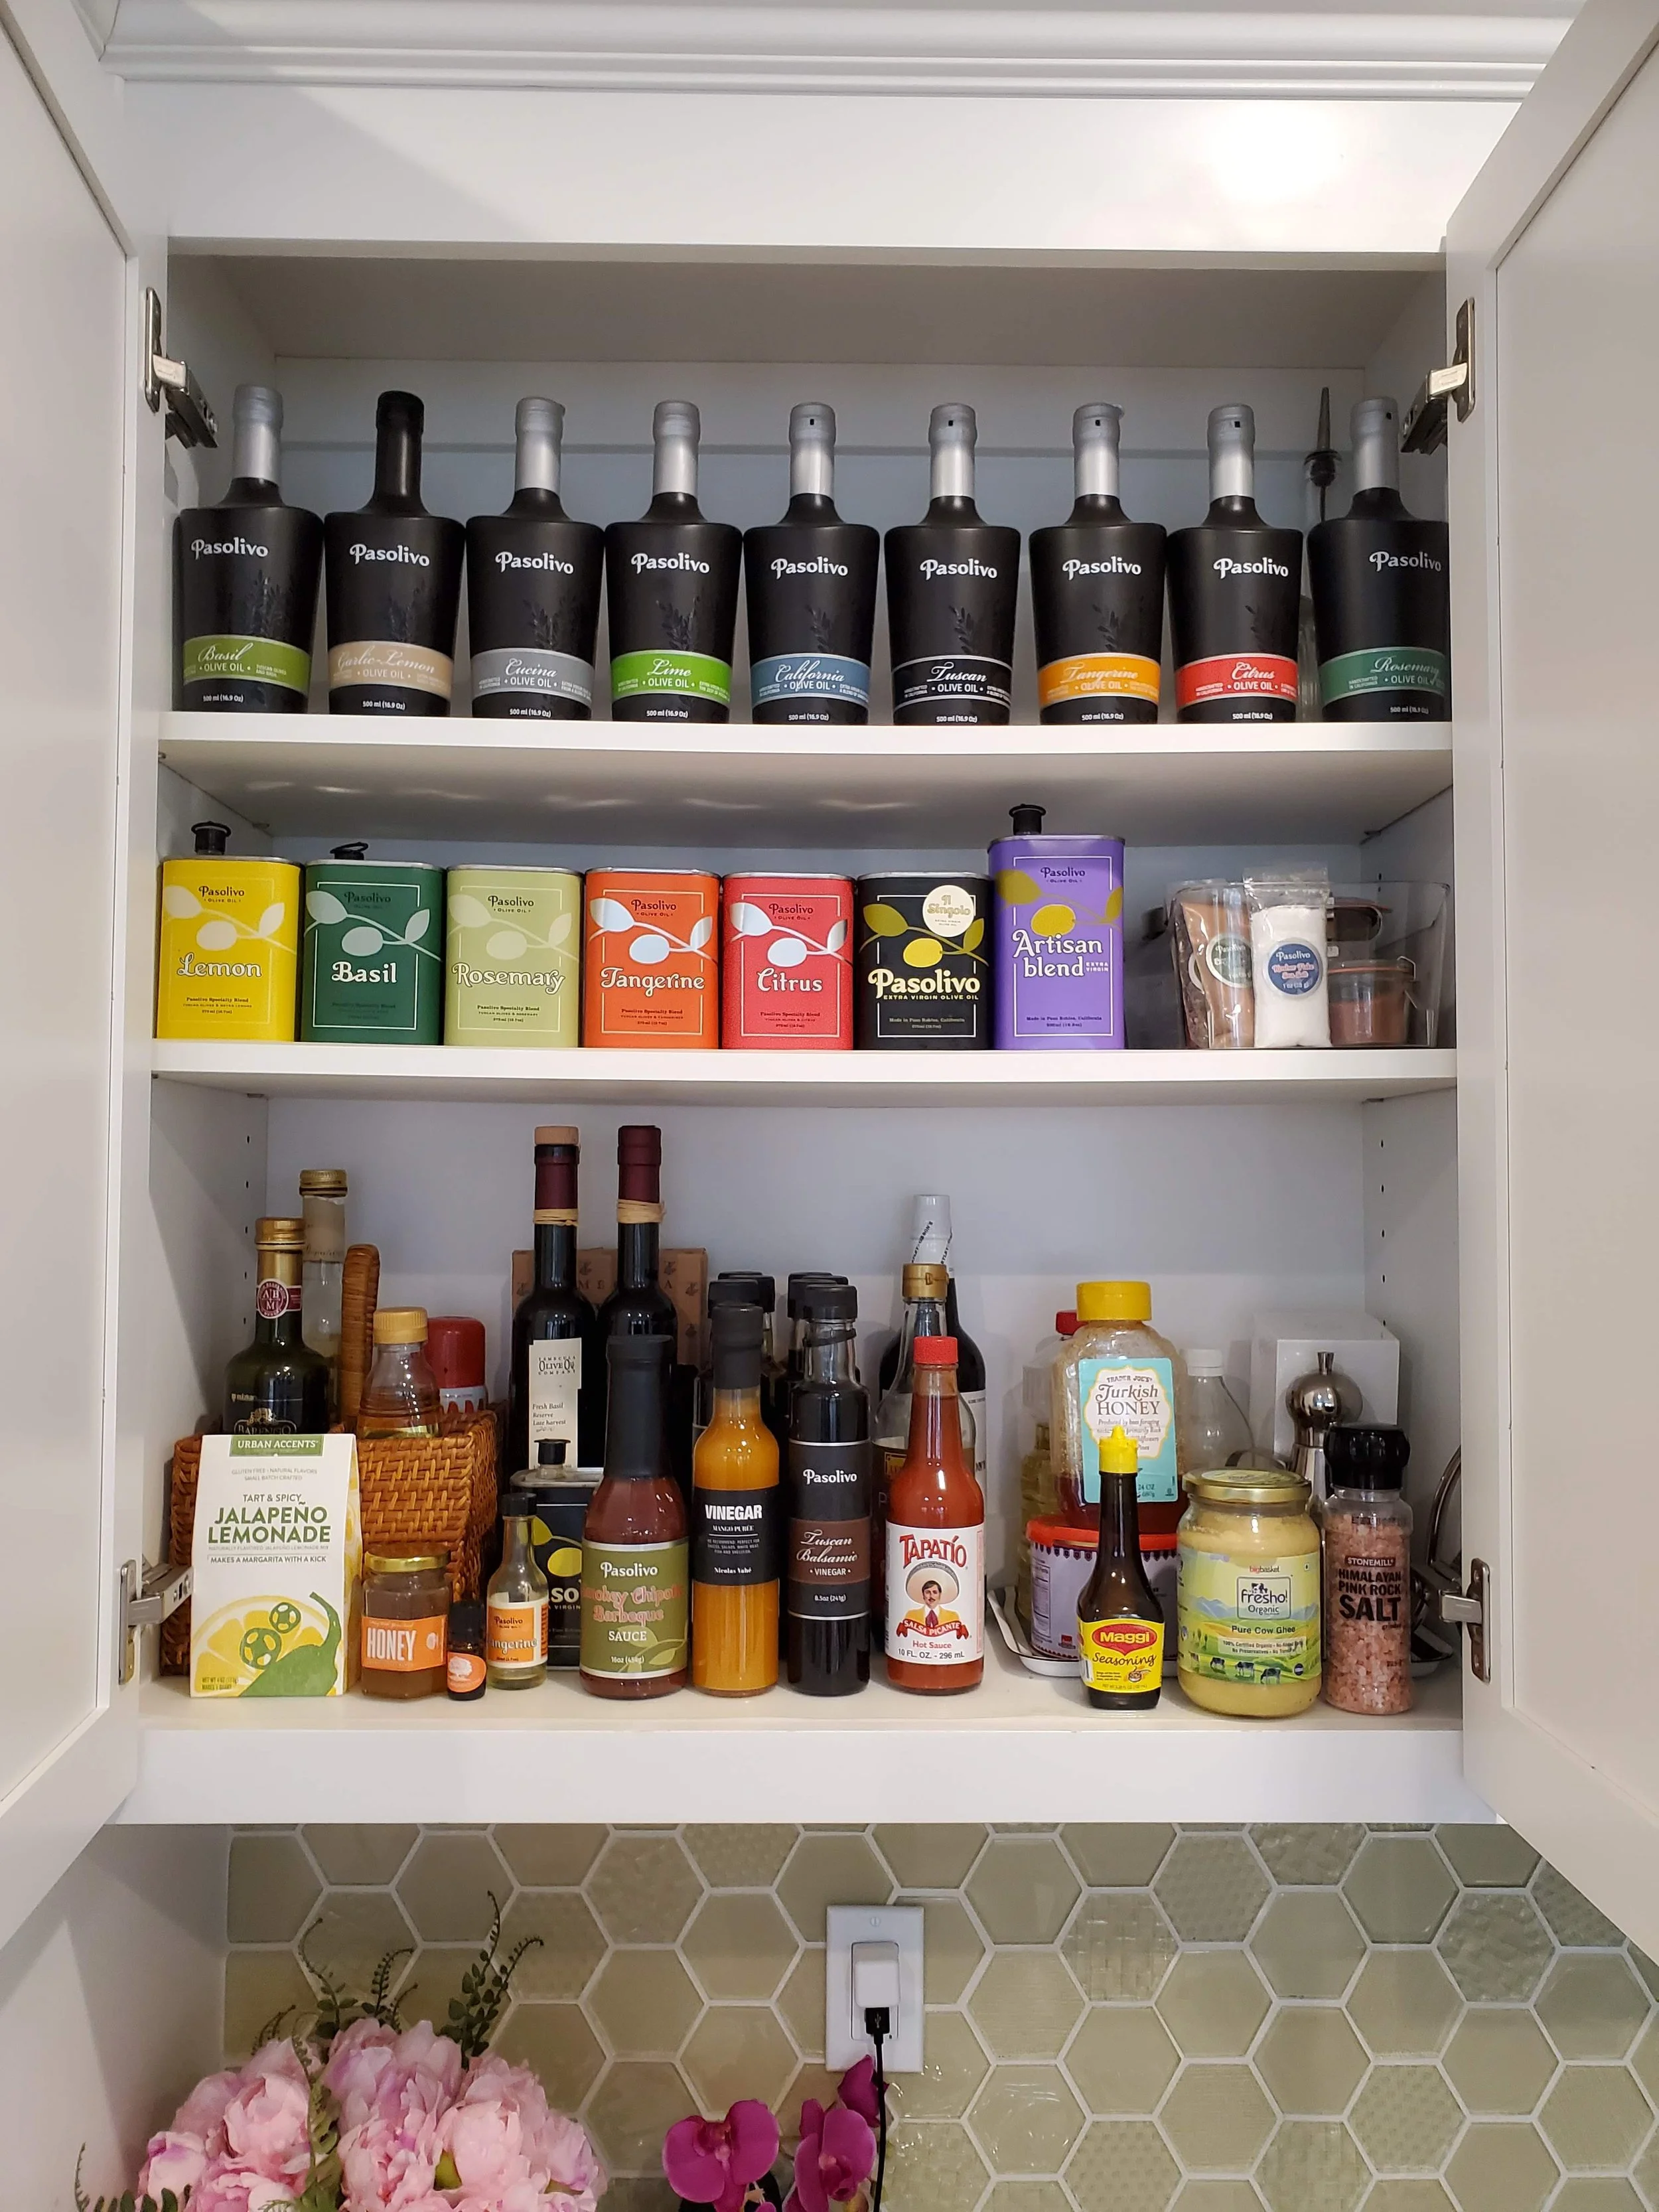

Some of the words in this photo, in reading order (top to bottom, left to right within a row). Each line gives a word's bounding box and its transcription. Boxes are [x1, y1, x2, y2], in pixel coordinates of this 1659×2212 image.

[191, 538, 268, 559] Pasolivo
[350, 544, 430, 567] Pasolivo
[495, 552, 573, 575] Pasolivo
[631, 552, 710, 574] Pasolivo
[770, 556, 849, 579] Pasolivo
[920, 558, 997, 580] Pasolivo
[1062, 556, 1141, 580] Pasolivo
[1213, 557, 1289, 579] Pasolivo
[1369, 551, 1441, 573] Pasolivo
[198, 642, 253, 662] Basil
[204, 663, 226, 672] OLIVE
[230, 663, 244, 672] OIL
[363, 669, 388, 678] OLIVE
[391, 670, 404, 679] OIL
[506, 658, 557, 677] Cucina
[647, 658, 691, 676] Lime
[926, 662, 987, 682] Tuscan
[1060, 662, 1139, 686] Tangerine
[1232, 662, 1275, 680] Citrus
[1370, 655, 1439, 685] Rosemary
[510, 677, 535, 686] OLIVE
[538, 678, 551, 688] OIL
[648, 678, 673, 687] OLIVE
[675, 678, 689, 688] OIL
[775, 660, 845, 692] California
[1417, 676, 1429, 685] OIL
[790, 681, 814, 690] OLIVE
[816, 681, 830, 690] OIL
[937, 684, 963, 692] OLIVE
[964, 684, 978, 693] OIL
[1080, 681, 1106, 690] OLIVE
[1108, 681, 1122, 690] OIL
[1234, 682, 1259, 690] OLIVE
[1260, 682, 1273, 690] OIL
[1041, 867, 1086, 878] Pasolivo
[198, 886, 245, 898] Pasolivo
[344, 891, 392, 903] Pasolivo
[488, 895, 534, 907] Pasolivo
[631, 899, 677, 911] Pasolivo
[768, 903, 814, 915] Pasolivo
[927, 903, 971, 919] Singolo
[1012, 929, 1103, 958] Artisan
[1276, 950, 1311, 962] Pasolivo
[177, 952, 262, 978] Lemon
[331, 960, 397, 984] Basil
[1023, 956, 1085, 978] blend
[452, 962, 565, 994] Rosemary
[600, 967, 705, 997] Tangerine
[757, 968, 824, 992] Citrus
[868, 968, 981, 999] Pasolivo
[539, 1361, 563, 1372] OLIVE
[1096, 1384, 1158, 1401] Turkish
[1097, 1401, 1160, 1416] HONEY
[238, 1440, 271, 1449] URBAN
[274, 1439, 317, 1449] ACCENTS
[803, 1469, 857, 1485] Pasolivo
[243, 1494, 264, 1503] TART
[275, 1494, 302, 1503] SPICY
[214, 1501, 328, 1524] JALAPEÑO
[705, 1505, 762, 1520] VINEGAR
[208, 1526, 331, 1544] LEMONADE
[800, 1529, 853, 1546] Tuscan
[796, 1545, 858, 1563] Balsamic
[899, 1534, 967, 1569] TAPATÍO
[600, 1562, 658, 1578] Pasolivo
[1250, 1566, 1279, 1574] bigbasket
[1348, 1558, 1392, 1567] STONEMILL
[814, 1568, 846, 1576] VINEGAR
[1338, 1568, 1401, 1583] HIMALAYAN
[1241, 1589, 1288, 1603] fresho!
[1338, 1581, 1366, 1594] PINK
[1370, 1584, 1401, 1595] ROCK
[830, 1593, 846, 1603] (241g)
[593, 1605, 664, 1626] Barbeque
[1248, 1605, 1279, 1615] Organic
[1339, 1594, 1401, 1621] SALT
[494, 1616, 523, 1625] Pasolivo
[904, 1620, 926, 1635] SALSA
[929, 1621, 961, 1635] PICANTE
[367, 1627, 417, 1661] HONEY
[608, 1631, 647, 1641] SAUCE
[1100, 1631, 1150, 1644] Maggi
[492, 1639, 539, 1655] ngerine
[912, 1640, 927, 1649] Hot
[1092, 1652, 1157, 1666] Seasoning
